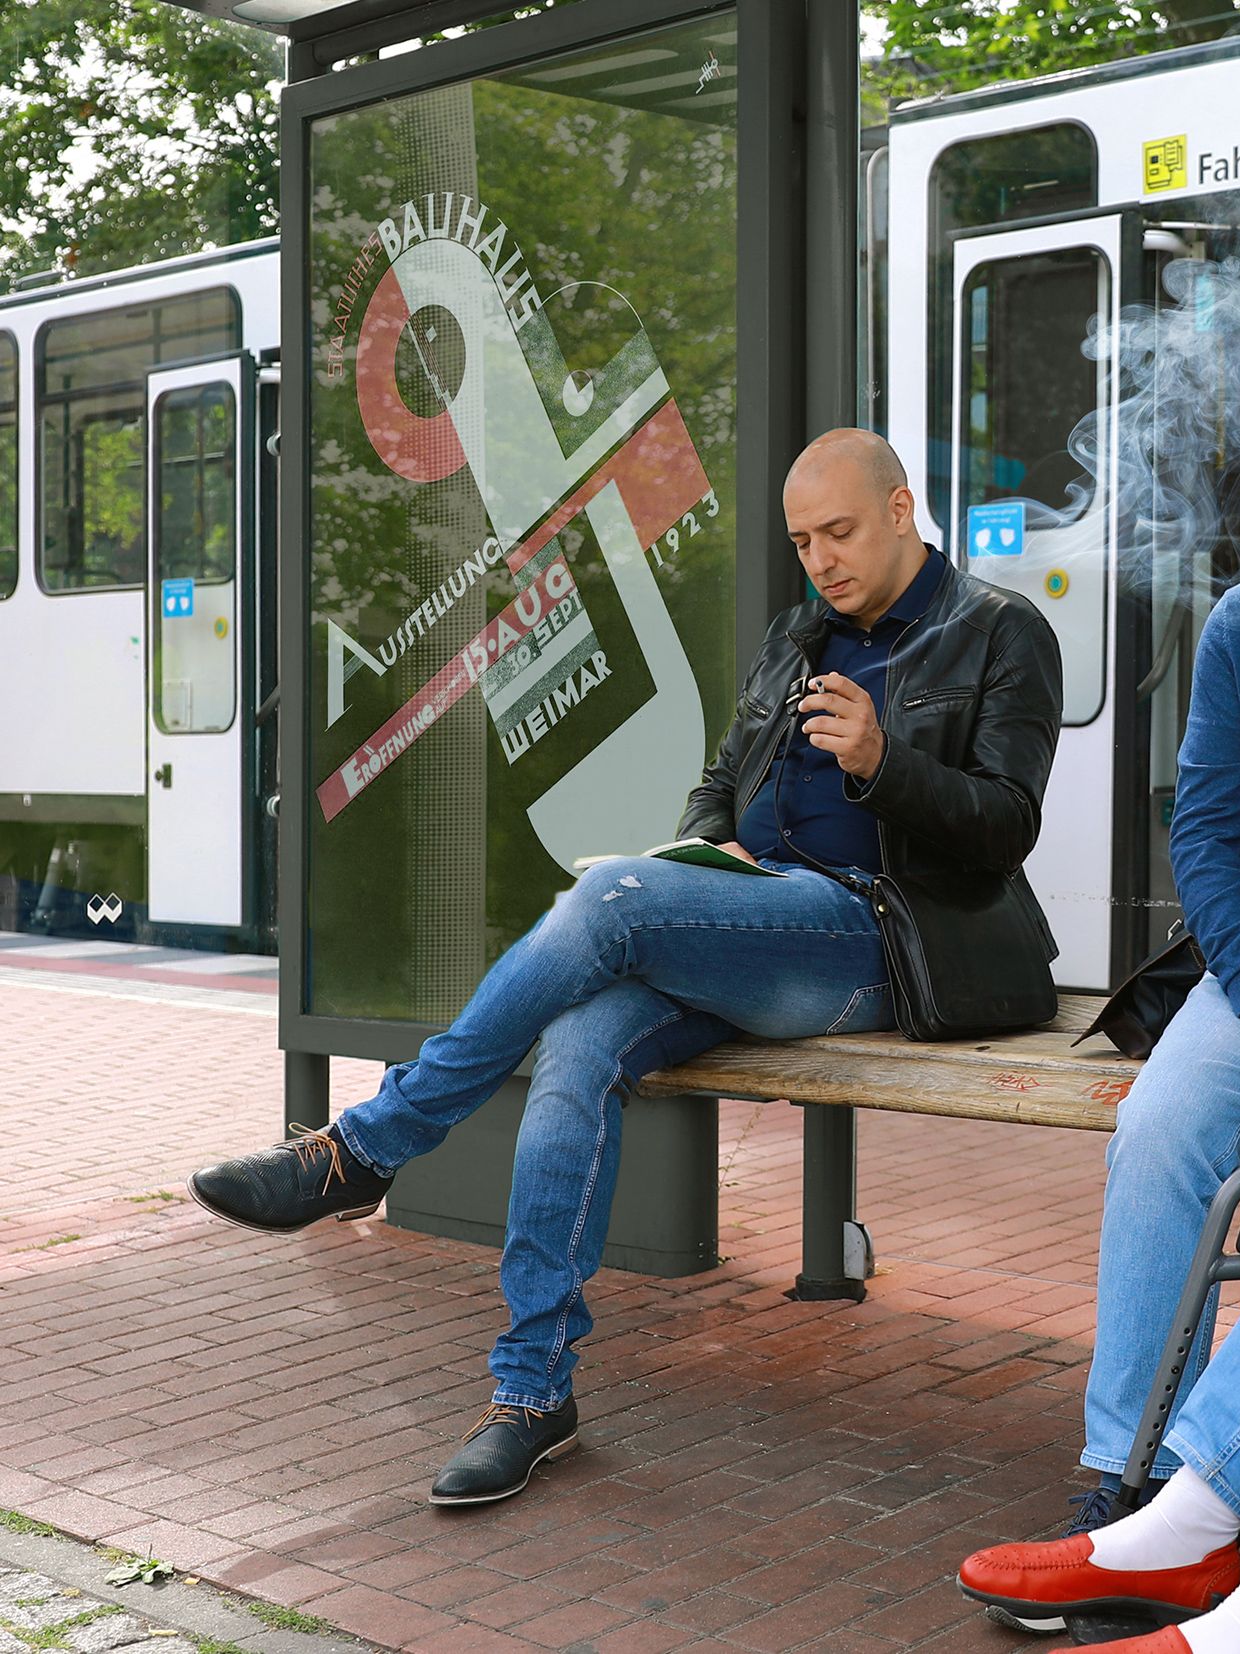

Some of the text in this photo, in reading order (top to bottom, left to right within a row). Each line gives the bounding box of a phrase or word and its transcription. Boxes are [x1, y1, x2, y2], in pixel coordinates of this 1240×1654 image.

[327, 231, 384, 378] STAATLICHES
[377, 192, 543, 332] BAUHAUS
[651, 488, 719, 568] 1923
[325, 537, 502, 732] AUSSTELLUNG
[340, 704, 436, 798] ERÖFFNUNG
[501, 650, 613, 767] WEIMAR
